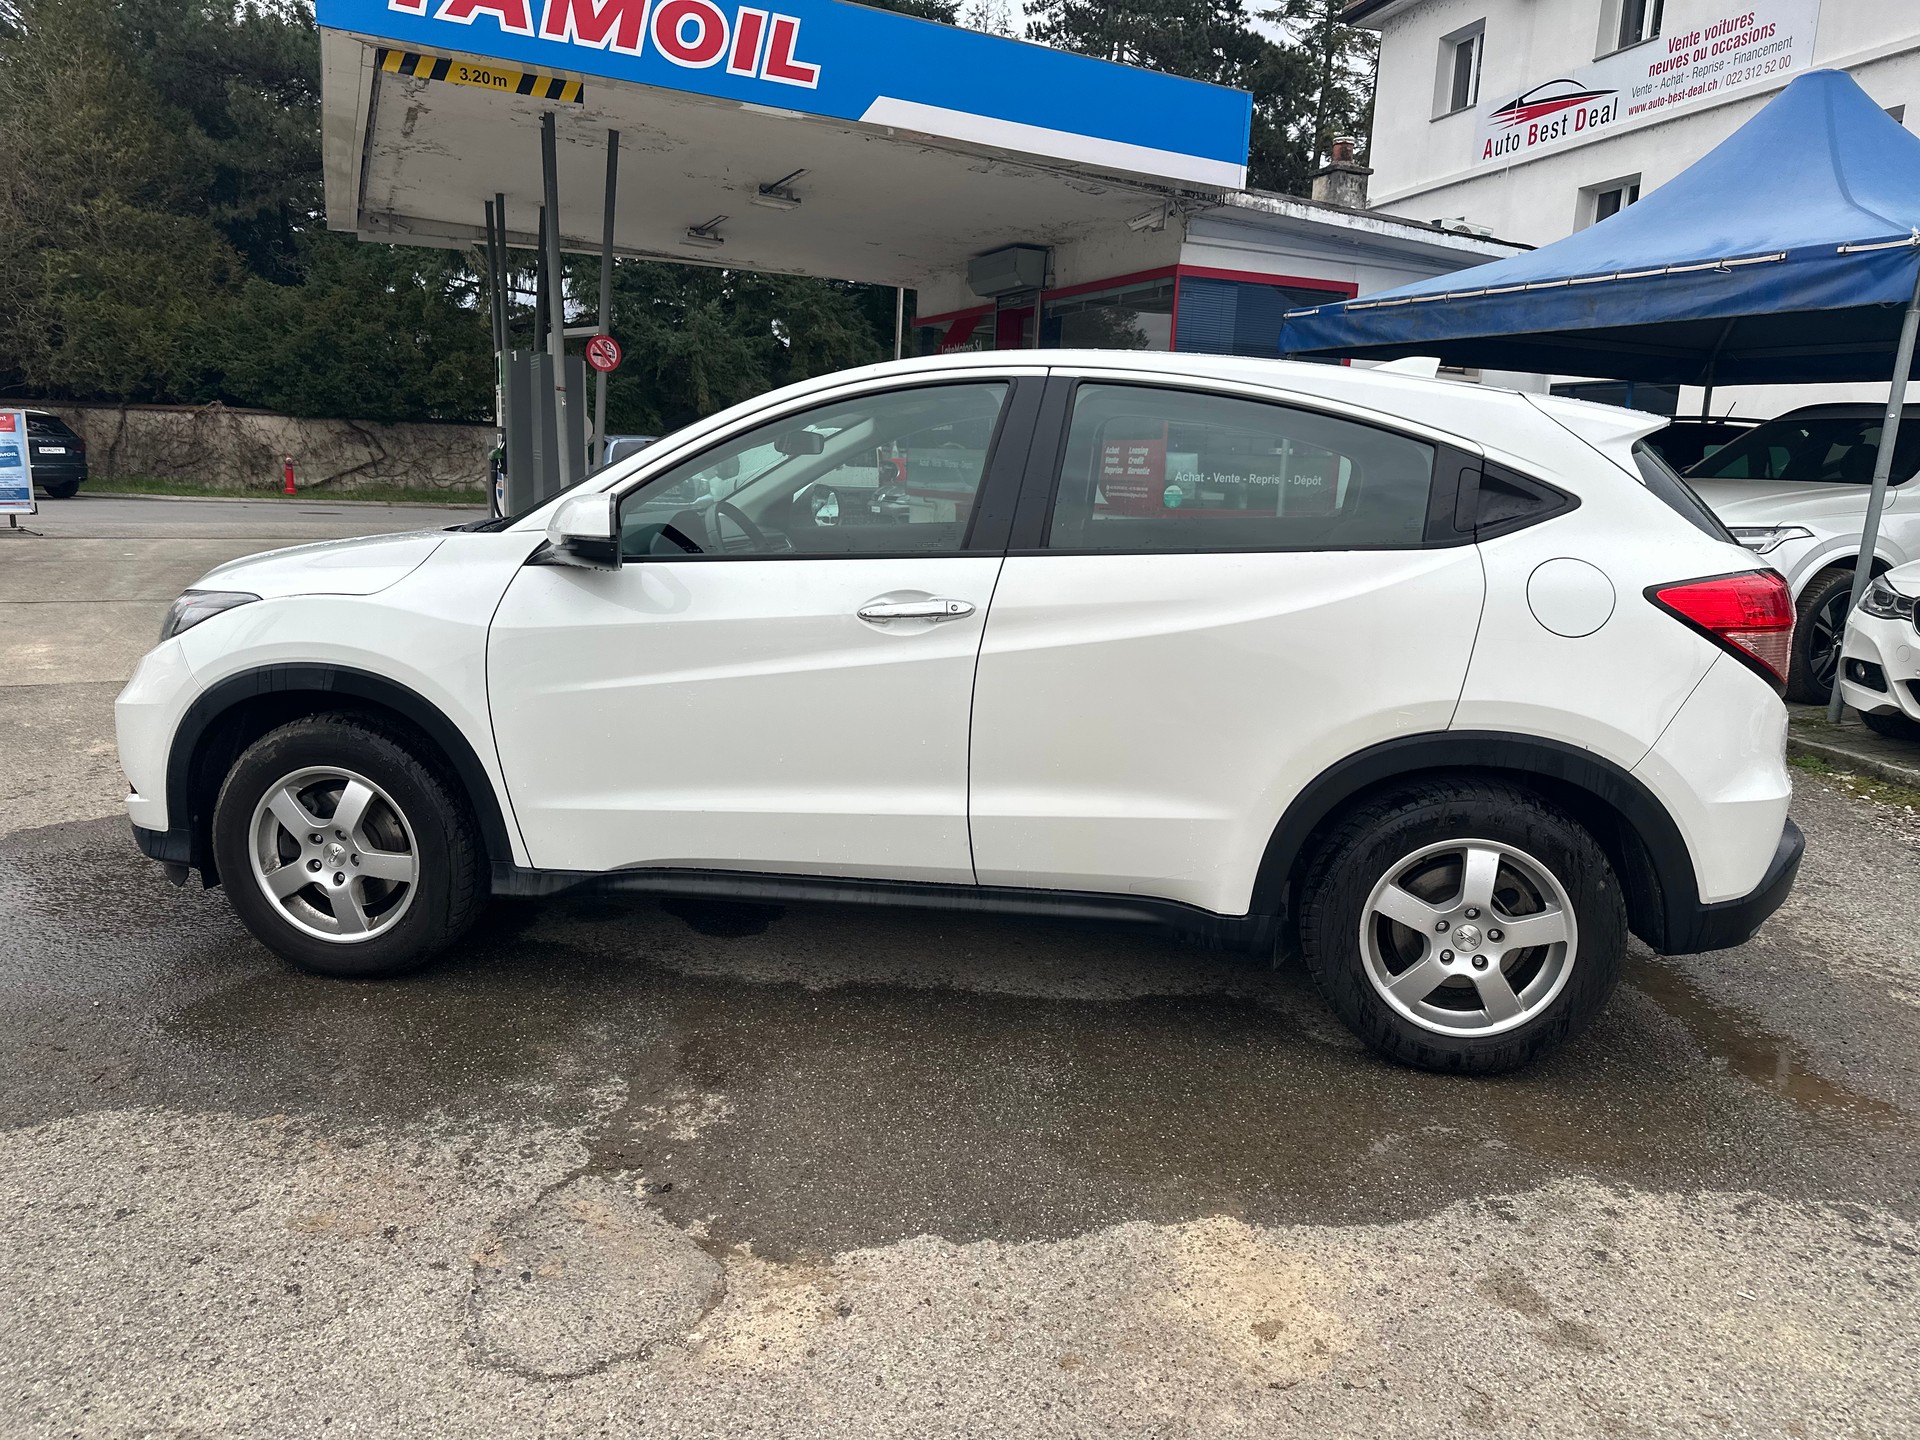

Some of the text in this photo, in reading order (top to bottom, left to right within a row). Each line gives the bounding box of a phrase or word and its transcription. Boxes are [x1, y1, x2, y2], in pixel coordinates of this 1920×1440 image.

[388, 0, 821, 90] AMOIL
[1648, 22, 1776, 77] neuves ou occasions
[1668, 11, 1755, 54] Vente voitures
[459, 67, 507, 87] 3.20 m
[1628, 78, 1718, 116] www.auto-best-deal.ch
[1725, 71, 1743, 86] 022
[1744, 65, 1762, 81] 312
[1764, 59, 1777, 74] 52
[1778, 54, 1792, 69] 00
[1631, 82, 1653, 98] Vente
[1660, 72, 1684, 89] Achat
[1692, 60, 1724, 80] Reprise
[1733, 35, 1793, 66] Financement
[1482, 97, 1618, 160] Auto Best Deal
[511, 350, 517, 361] 1
[1175, 471, 1204, 482] Achat
[1213, 472, 1240, 483] Vente
[1249, 473, 1280, 487] Repris
[1294, 474, 1322, 487] Dépôt
